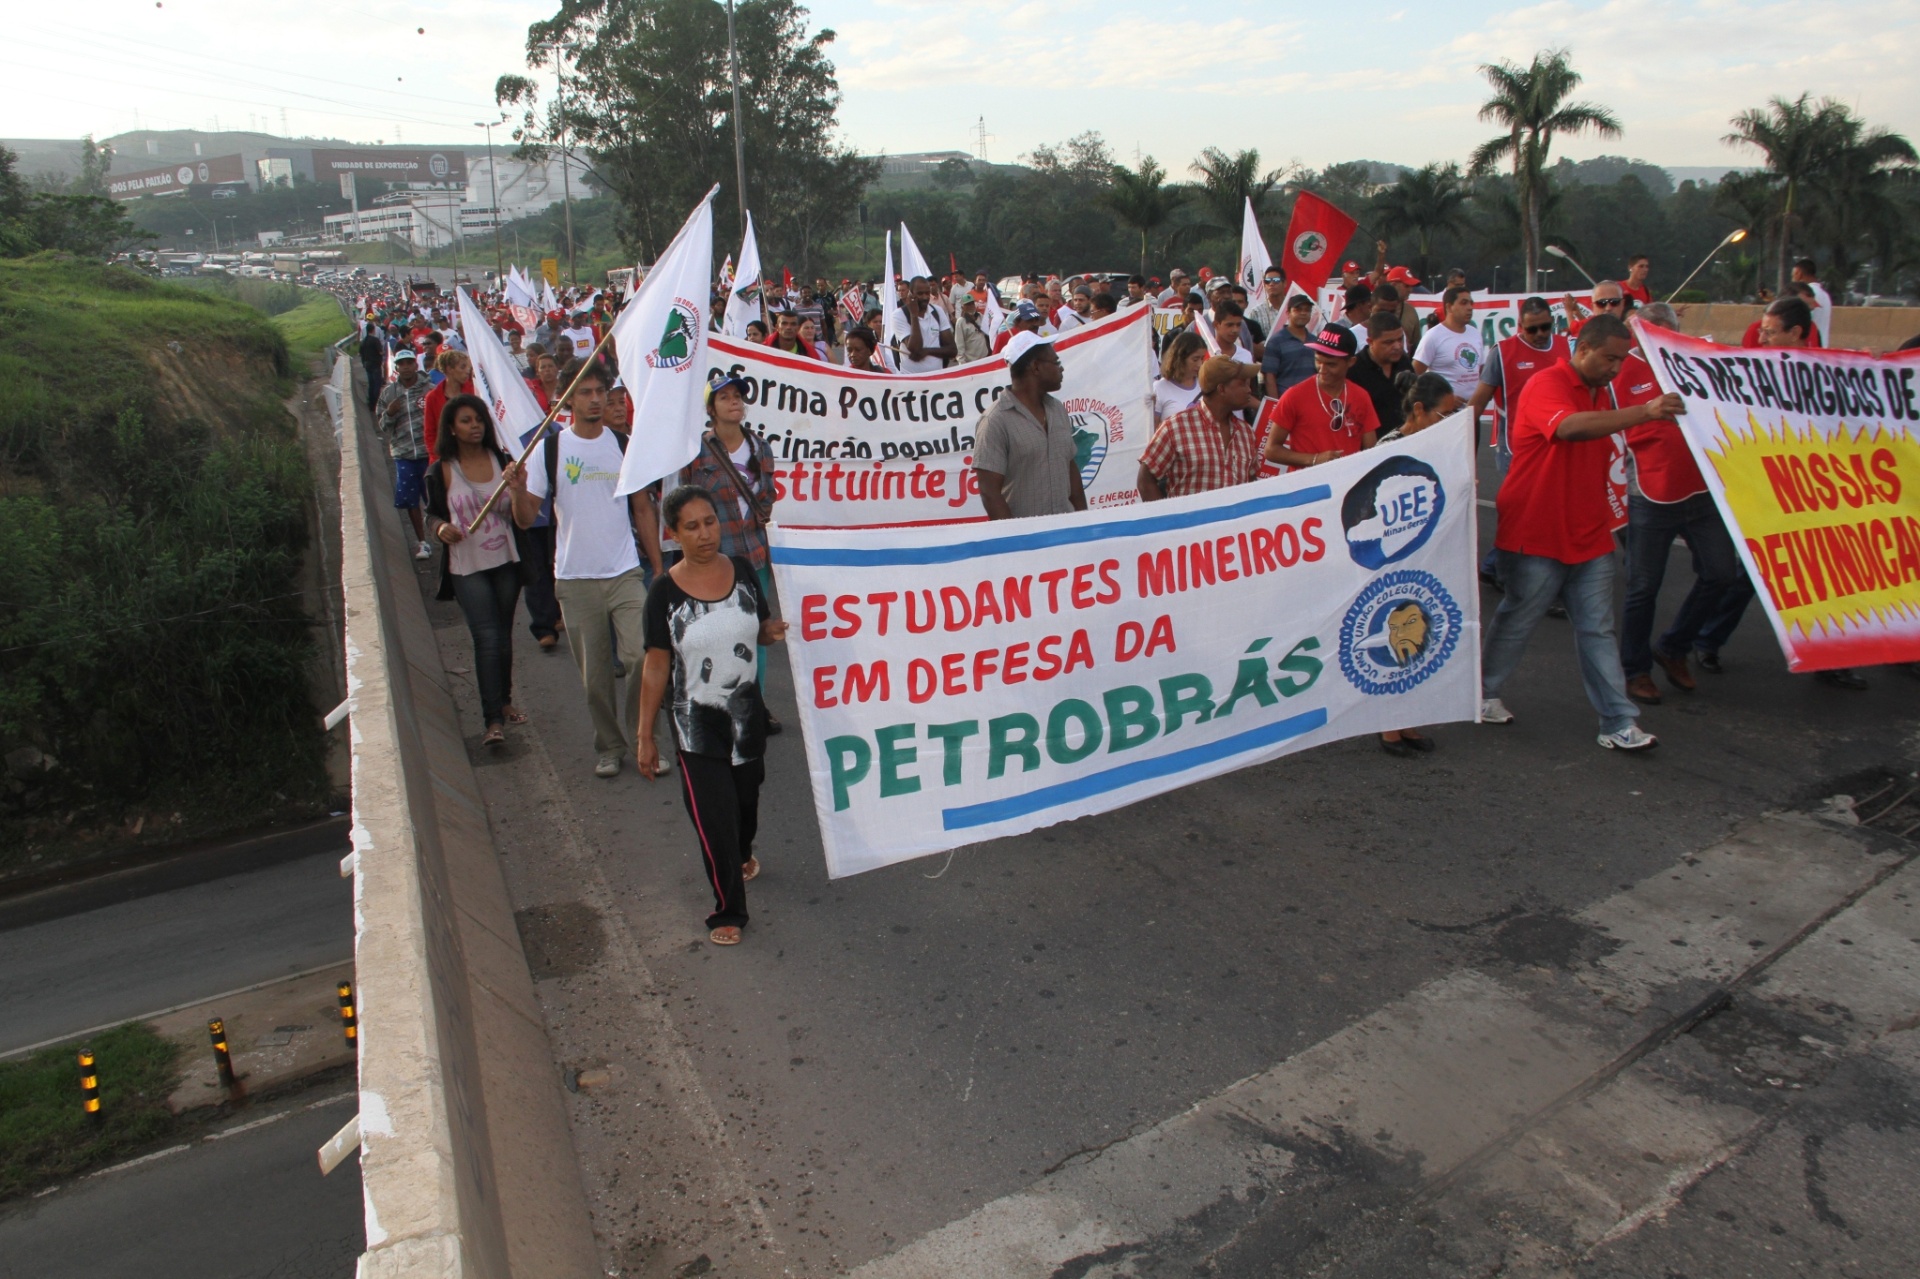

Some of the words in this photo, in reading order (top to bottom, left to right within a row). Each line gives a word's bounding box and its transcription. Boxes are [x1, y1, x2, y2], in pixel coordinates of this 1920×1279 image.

[128, 179, 145, 190] PELA
[145, 173, 172, 188] PAIXÃO
[331, 161, 363, 169] UNIDADE
[365, 161, 374, 169] DE
[1658, 347, 1708, 400] OS
[1690, 352, 1885, 418] METALÚRGICOS
[1883, 367, 1920, 421] DE
[838, 386, 965, 422] Política
[1063, 398, 1090, 413] GIDOS
[1089, 398, 1106, 412] POR
[880, 426, 975, 462] popula
[773, 461, 946, 502] stituinte
[1098, 488, 1140, 504] ENERGIA
[1606, 481, 1625, 519] ERAIS
[1761, 448, 1902, 515] NOSSAS
[1380, 485, 1428, 527] UEE
[1383, 524, 1407, 538] Minas
[1407, 516, 1430, 531] Gerais
[801, 558, 1120, 641] ESTUDANTES
[1137, 517, 1326, 599] MINEIROS
[1355, 604, 1374, 638] UNIÃO
[1376, 585, 1426, 605] COLEGIAL
[1424, 596, 1439, 612] DE
[813, 659, 890, 709] EM
[907, 632, 1095, 704] DEFESA
[1115, 614, 1176, 663] DA
[825, 637, 1324, 812] PETROBRÁS
